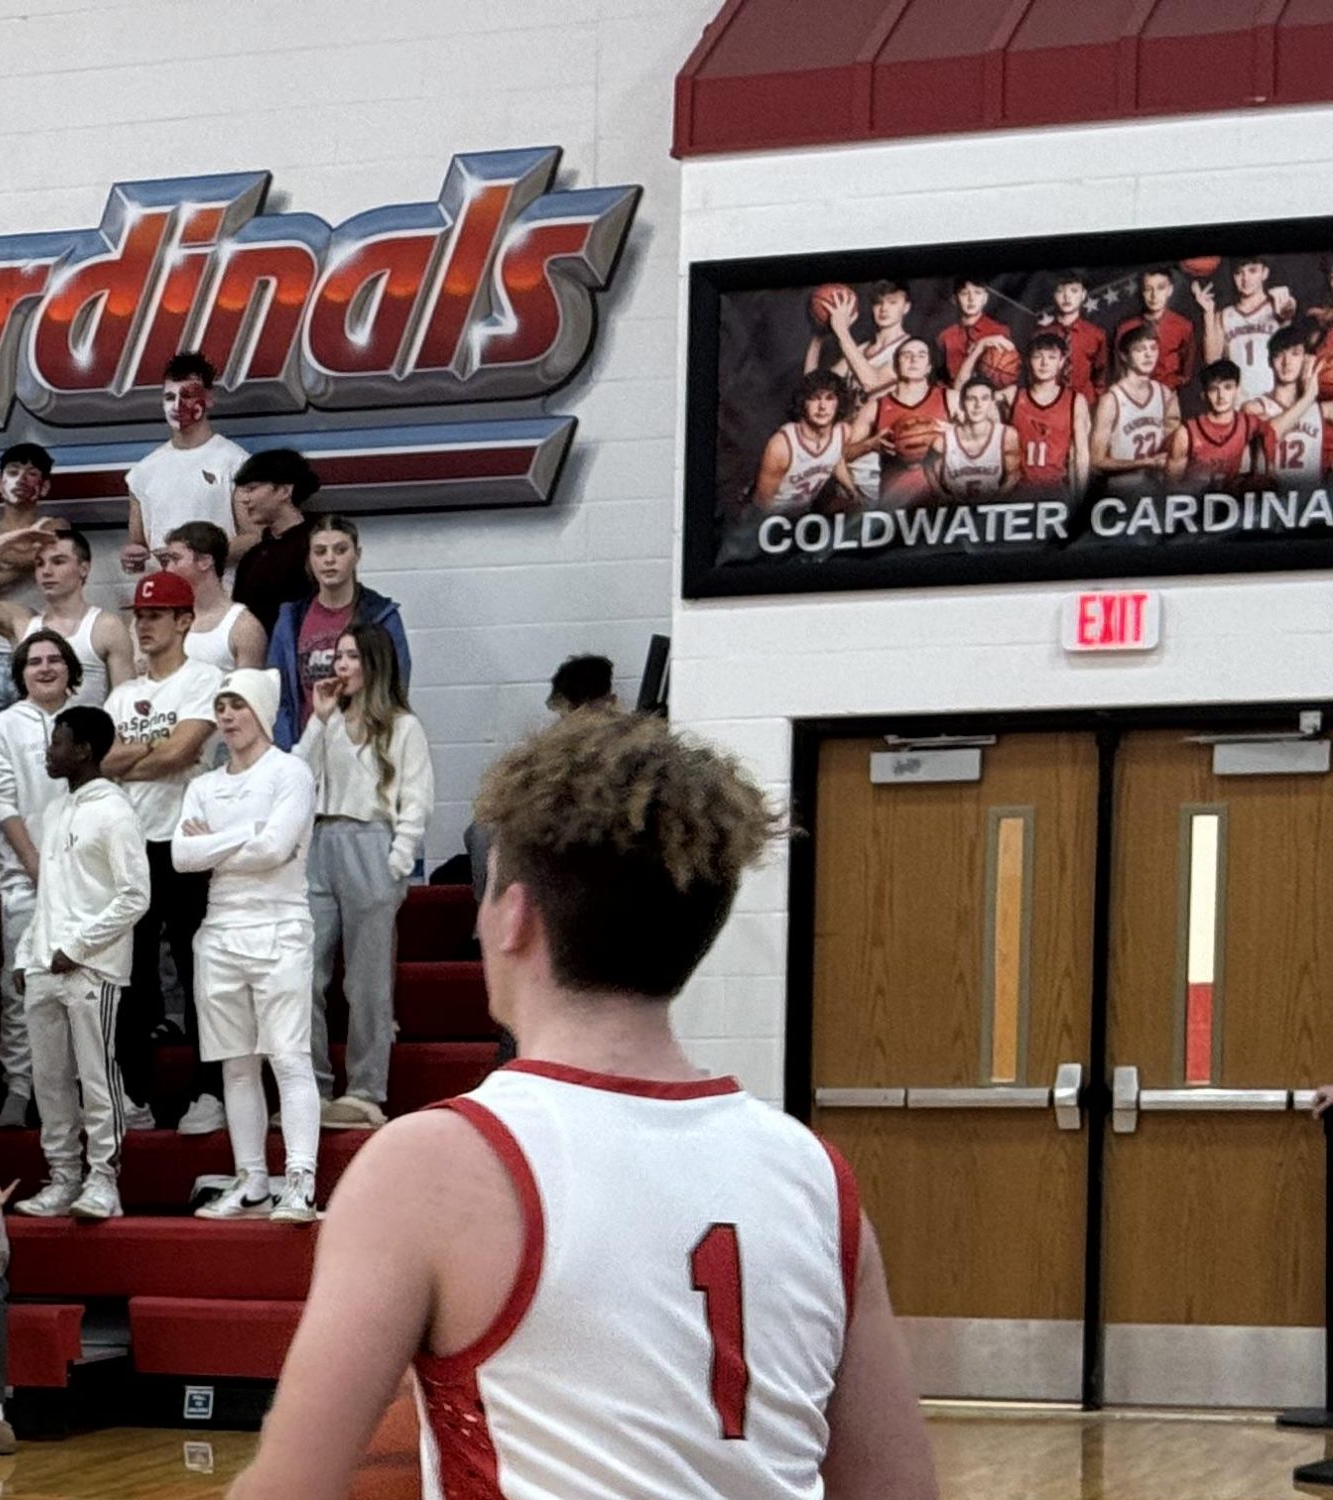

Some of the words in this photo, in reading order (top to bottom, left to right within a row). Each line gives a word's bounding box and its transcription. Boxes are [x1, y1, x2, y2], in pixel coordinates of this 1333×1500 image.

[1027, 441, 1046, 467] 11
[1280, 439, 1305, 469] 12
[758, 500, 1069, 555] COLDWATER
[1090, 488, 1333, 537] CARDINA
[142, 581, 154, 598] C
[1077, 593, 1150, 645] EXIT
[690, 1222, 751, 1442] 1
